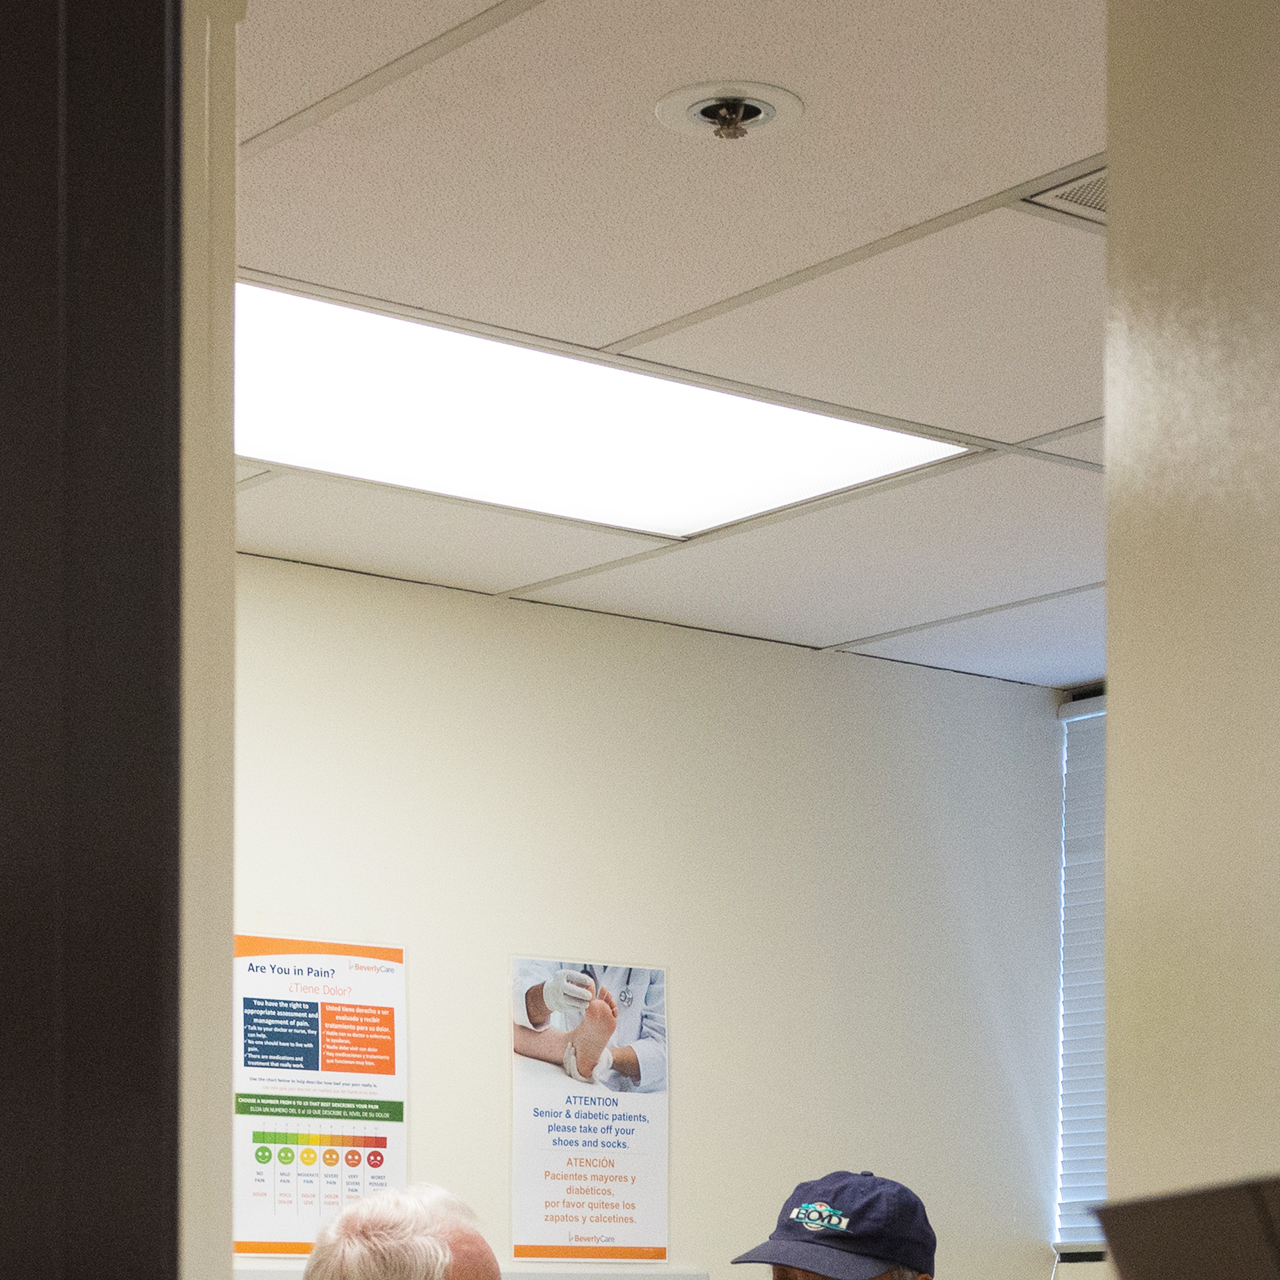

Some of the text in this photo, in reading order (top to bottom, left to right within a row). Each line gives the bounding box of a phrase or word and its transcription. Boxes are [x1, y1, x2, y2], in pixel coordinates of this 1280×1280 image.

[247, 962, 336, 978] Are You in Pain?
[354, 963, 395, 974] BeverlyCare
[289, 982, 352, 996] ¿Tiene Dolor?
[565, 1096, 618, 1107] ATTENTION
[533, 1108, 649, 1123] Senior & diabetic patients,
[548, 1123, 635, 1136] please take off your
[552, 1137, 629, 1149] shoes and socks.
[566, 1156, 615, 1168] ATENCIÓN
[544, 1171, 636, 1185] Pacientes mayores y
[566, 1185, 615, 1196] diabéticos,
[544, 1200, 559, 1209] por
[562, 1199, 585, 1209] favor
[622, 1201, 636, 1210] los
[544, 1214, 636, 1224] zapatos y calcetines.
[574, 1235, 615, 1244] BeverlyCare
